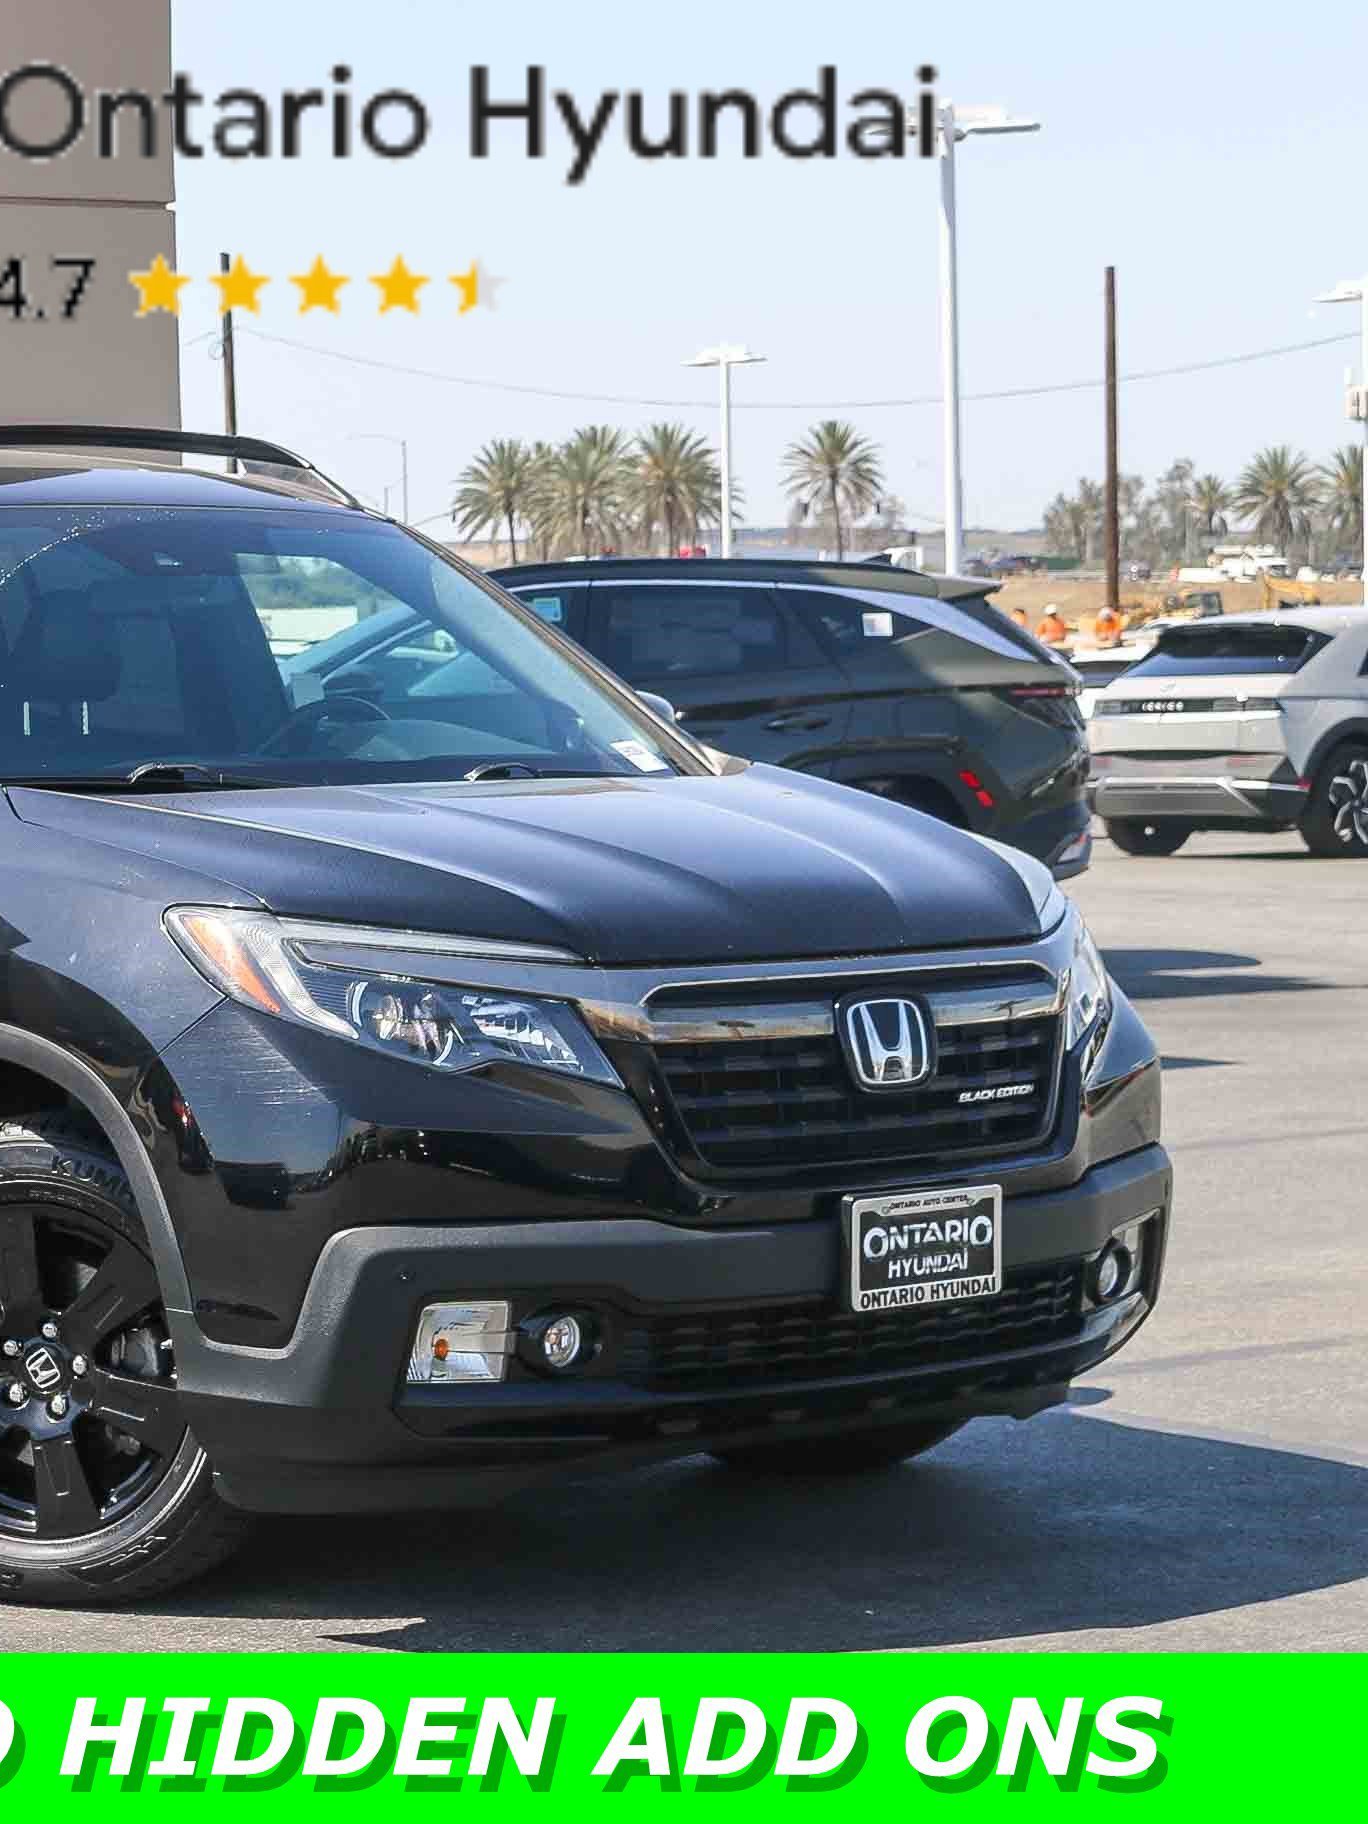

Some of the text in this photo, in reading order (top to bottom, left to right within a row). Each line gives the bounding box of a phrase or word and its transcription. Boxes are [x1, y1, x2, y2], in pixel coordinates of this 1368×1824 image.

[958, 1089, 995, 1103] BLACK
[863, 1215, 993, 1259] ONTARIO
[887, 1247, 969, 1280] HYUNDAI
[860, 1276, 997, 1309] ONTARIO HYUNDAI
